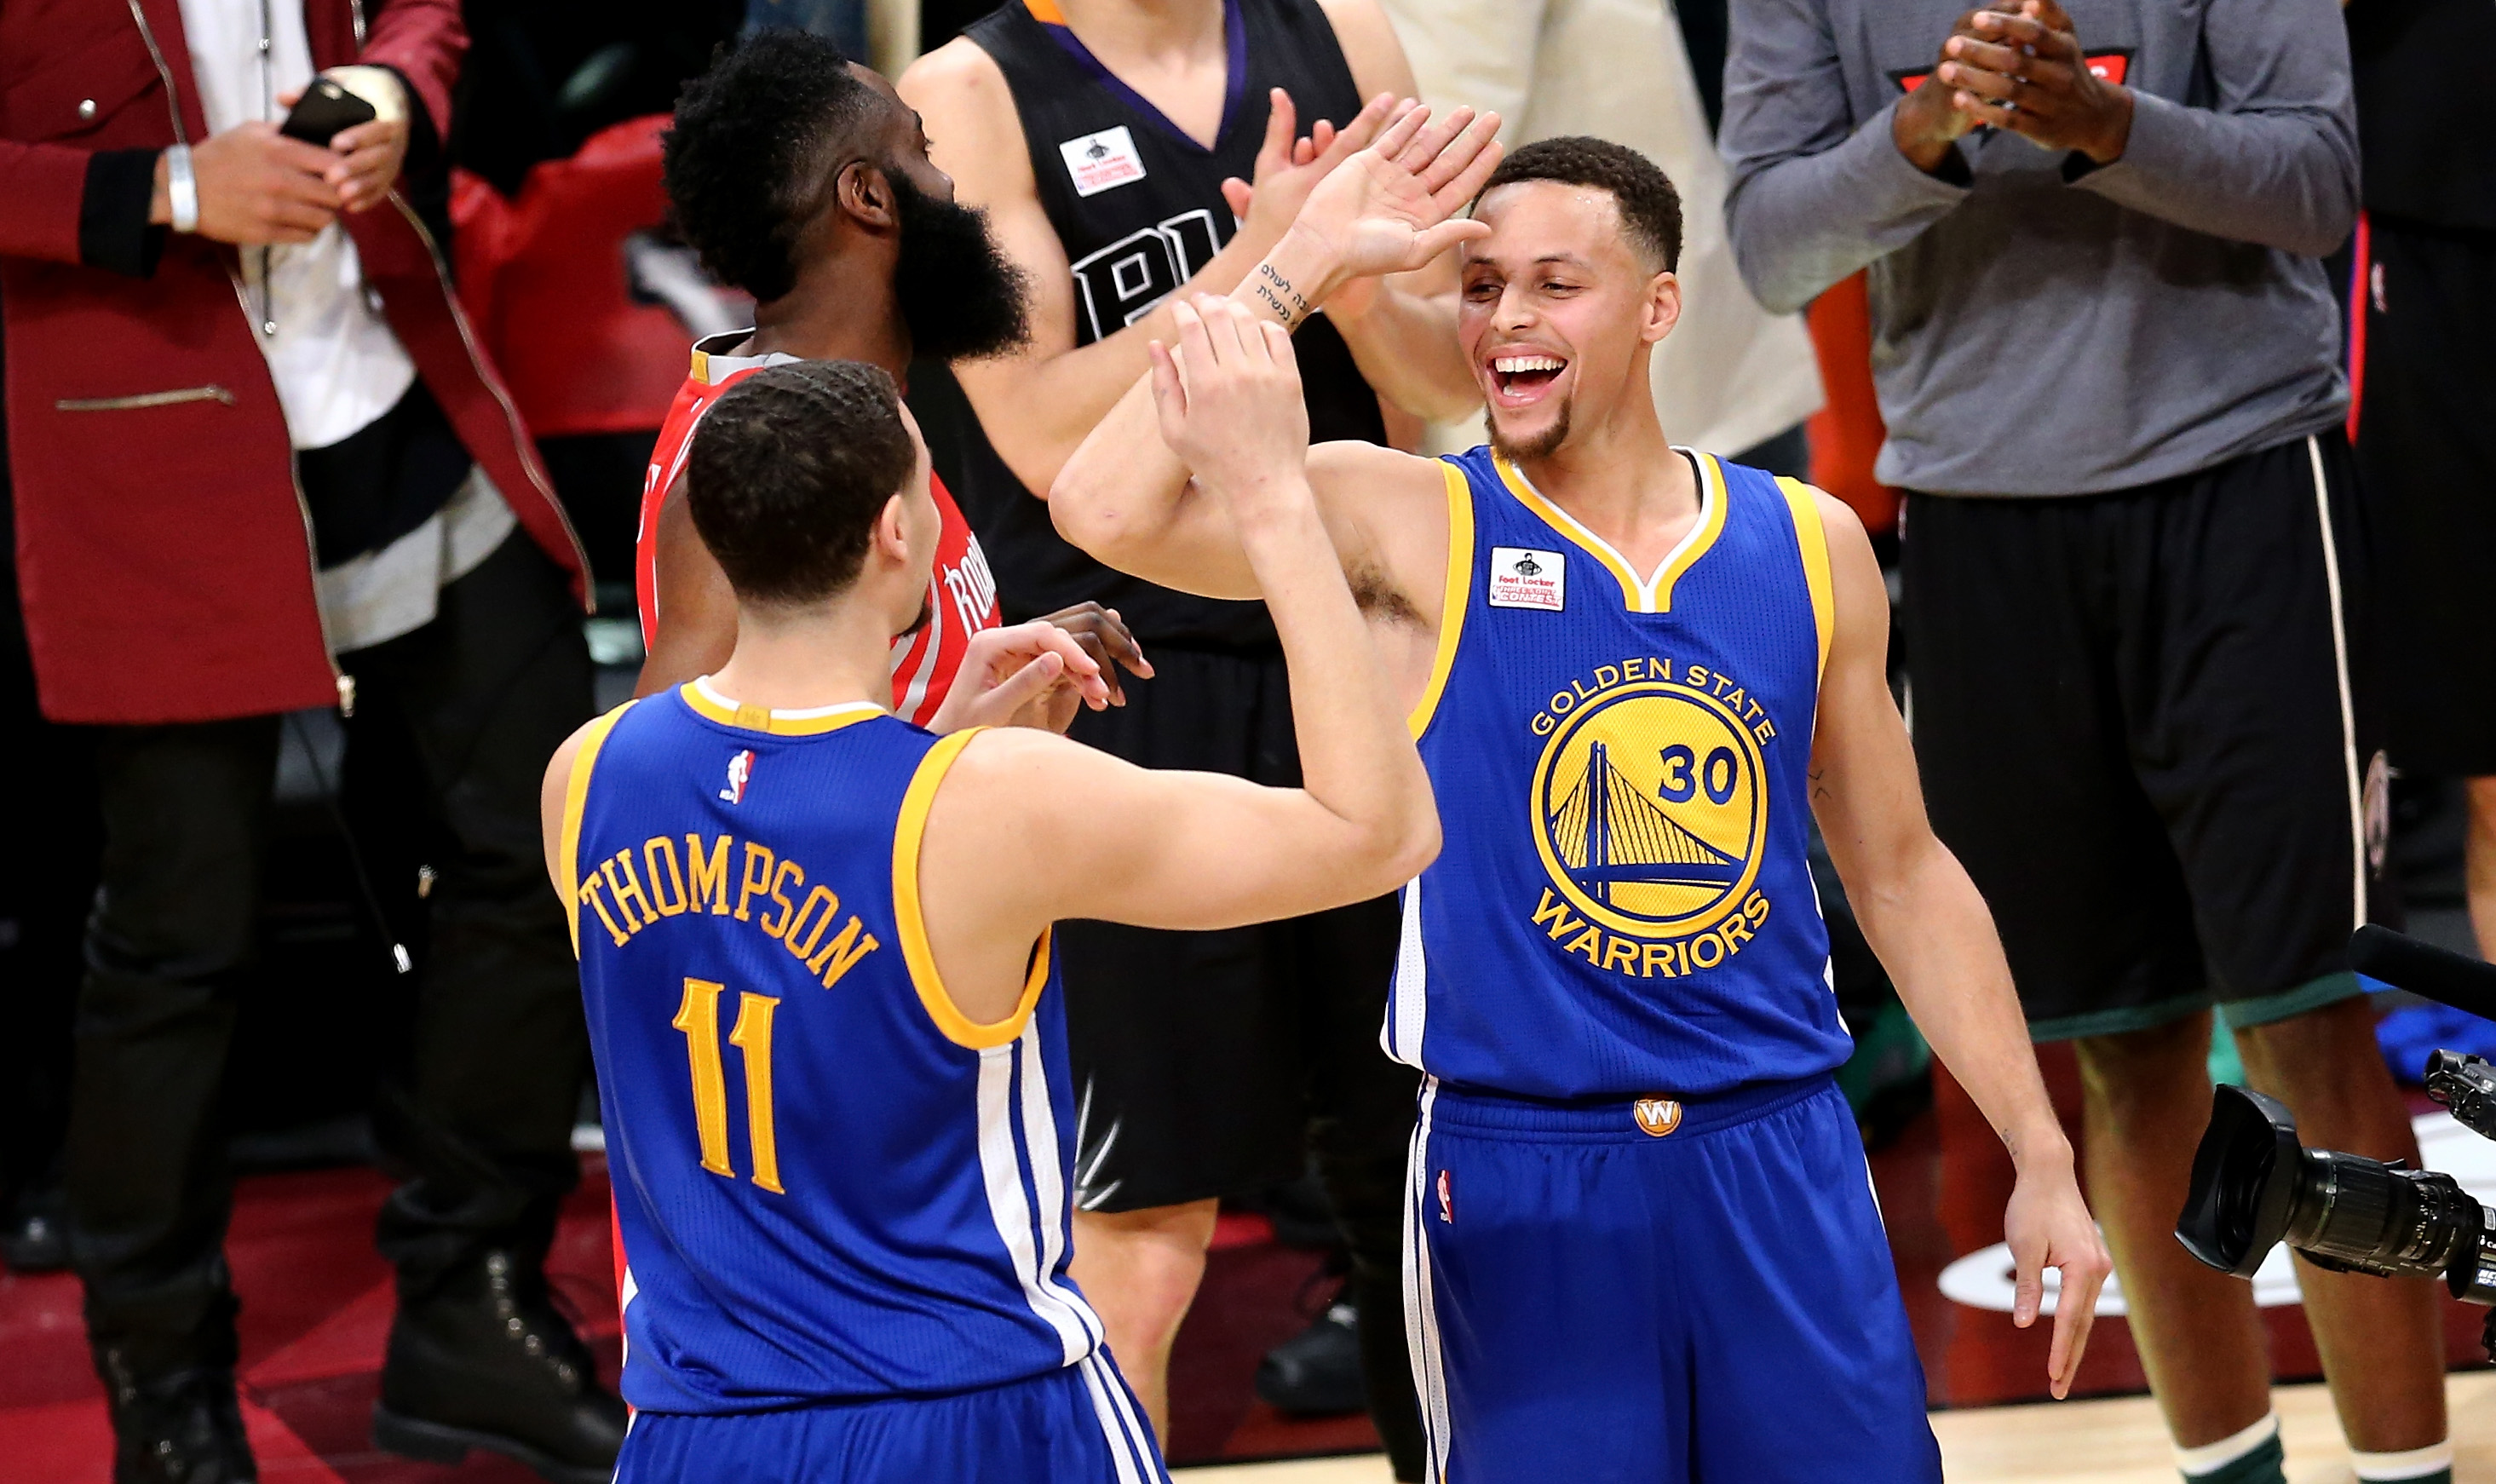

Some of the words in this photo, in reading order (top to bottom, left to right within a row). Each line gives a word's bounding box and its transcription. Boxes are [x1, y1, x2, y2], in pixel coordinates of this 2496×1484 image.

[1531, 658, 1671, 736] GOLDEN
[1686, 664, 1776, 746] STATE
[1658, 744, 1738, 805] 30
[578, 833, 880, 989] THOMPSON
[1532, 887, 1771, 978] WARRIORS
[671, 977, 785, 1195] 11
[1637, 1100, 1675, 1126] W
